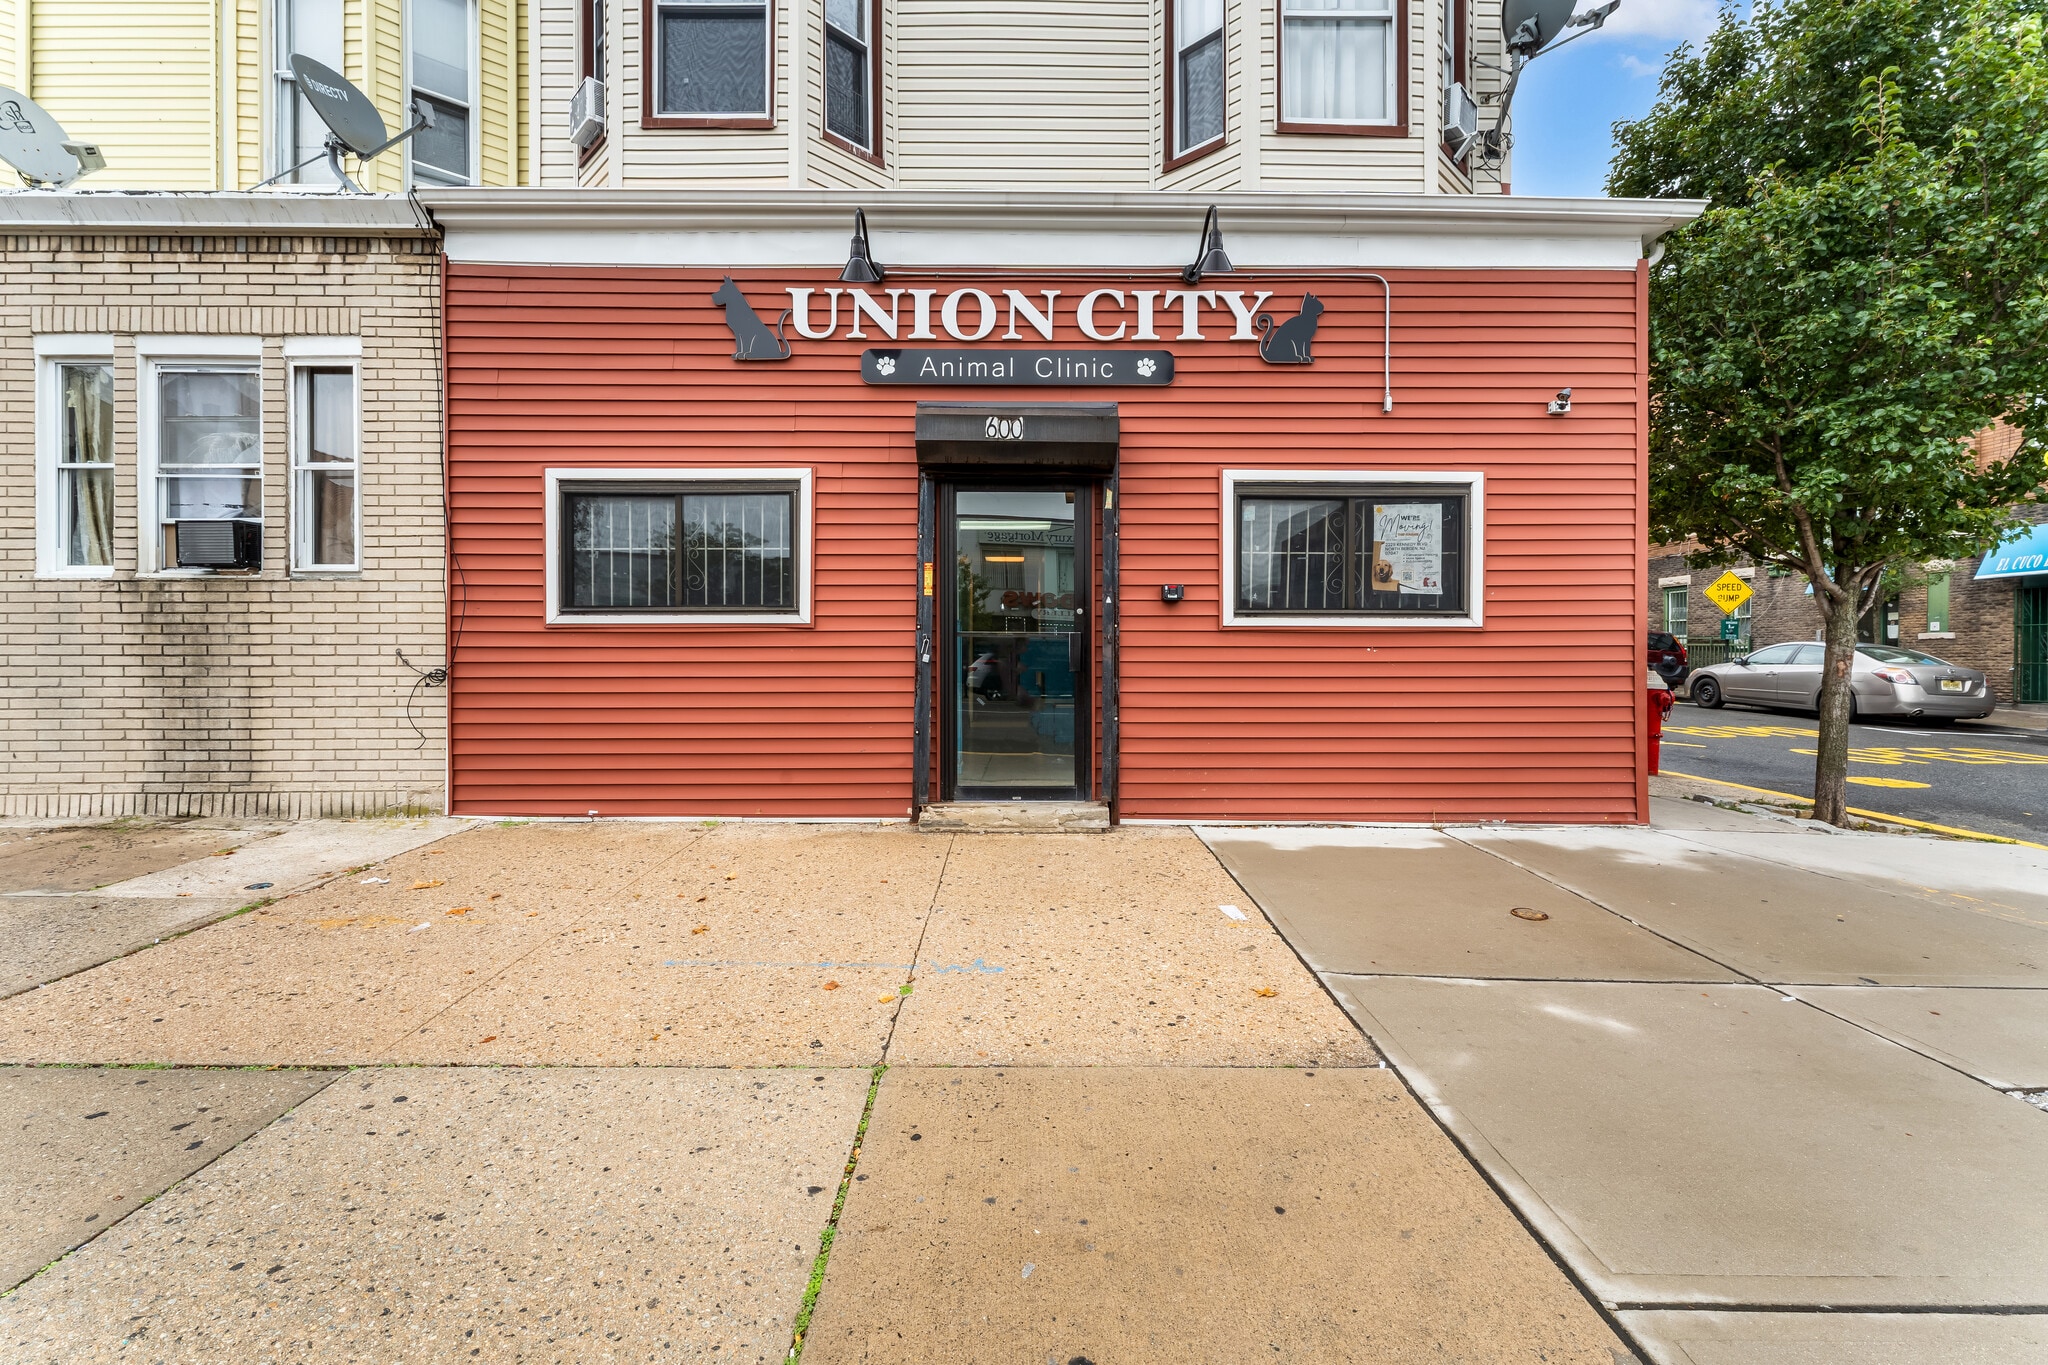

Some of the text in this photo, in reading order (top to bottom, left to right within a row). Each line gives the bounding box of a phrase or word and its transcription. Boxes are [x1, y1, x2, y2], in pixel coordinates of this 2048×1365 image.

[311, 79, 348, 102] DIRECTV
[785, 287, 1274, 341] UNION CITY
[919, 356, 1114, 378] Animal Clinic
[986, 416, 1023, 439] 600
[1996, 557, 2010, 571] EL
[2012, 554, 2043, 570] CUCO
[1717, 583, 1742, 591] SPEED
